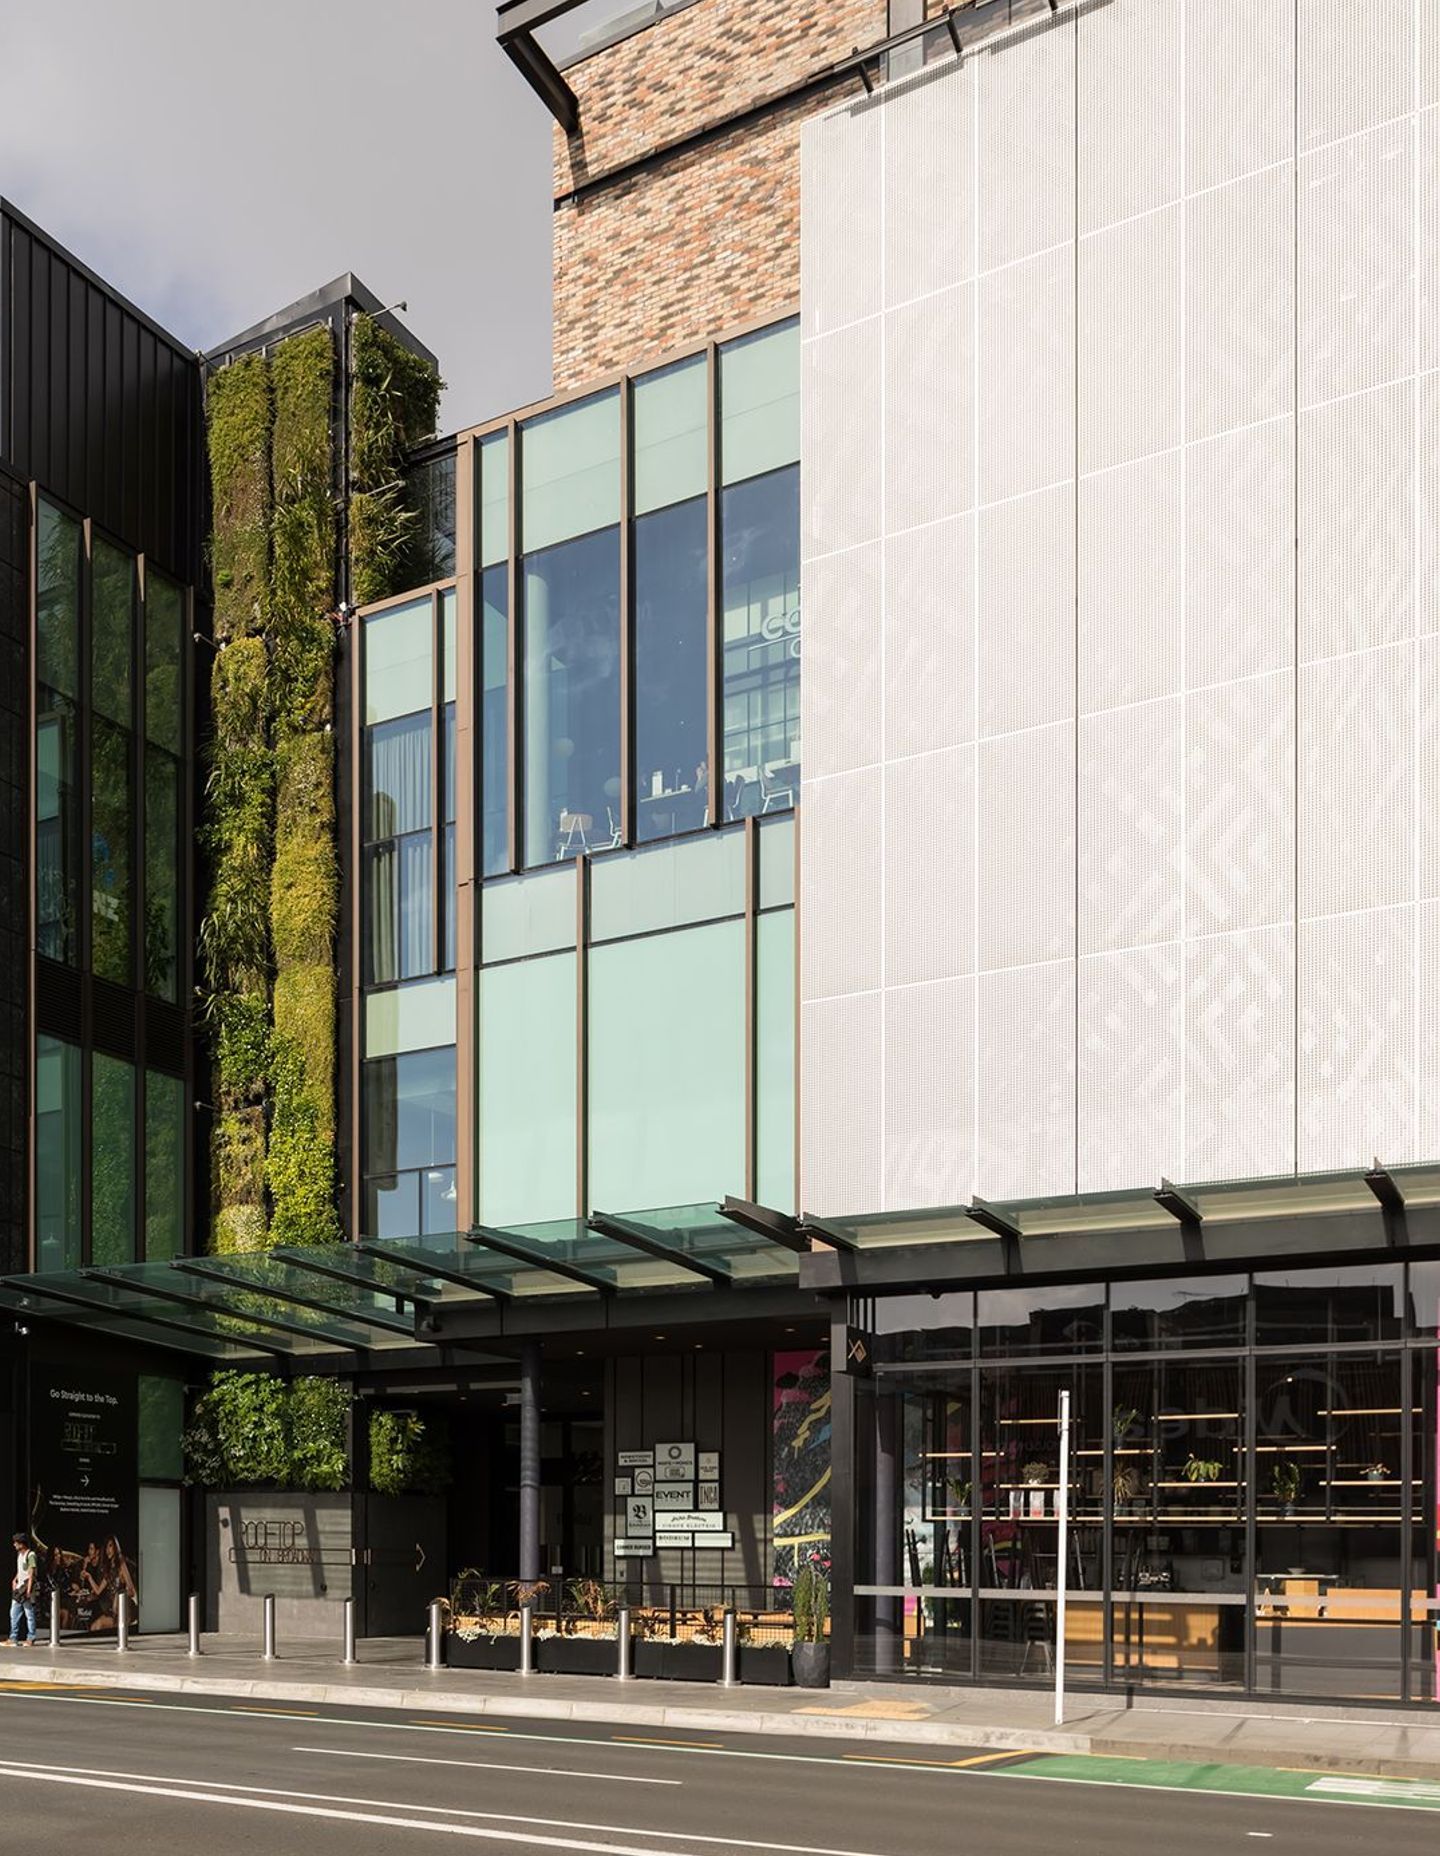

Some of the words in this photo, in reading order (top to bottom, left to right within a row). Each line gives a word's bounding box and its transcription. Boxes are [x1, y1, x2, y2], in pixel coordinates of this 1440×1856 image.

[49, 1388, 60, 1399] Go
[61, 1389, 85, 1402] Straight
[86, 1393, 94, 1402] to
[94, 1393, 105, 1403] the
[656, 1490, 691, 1500] EVENT
